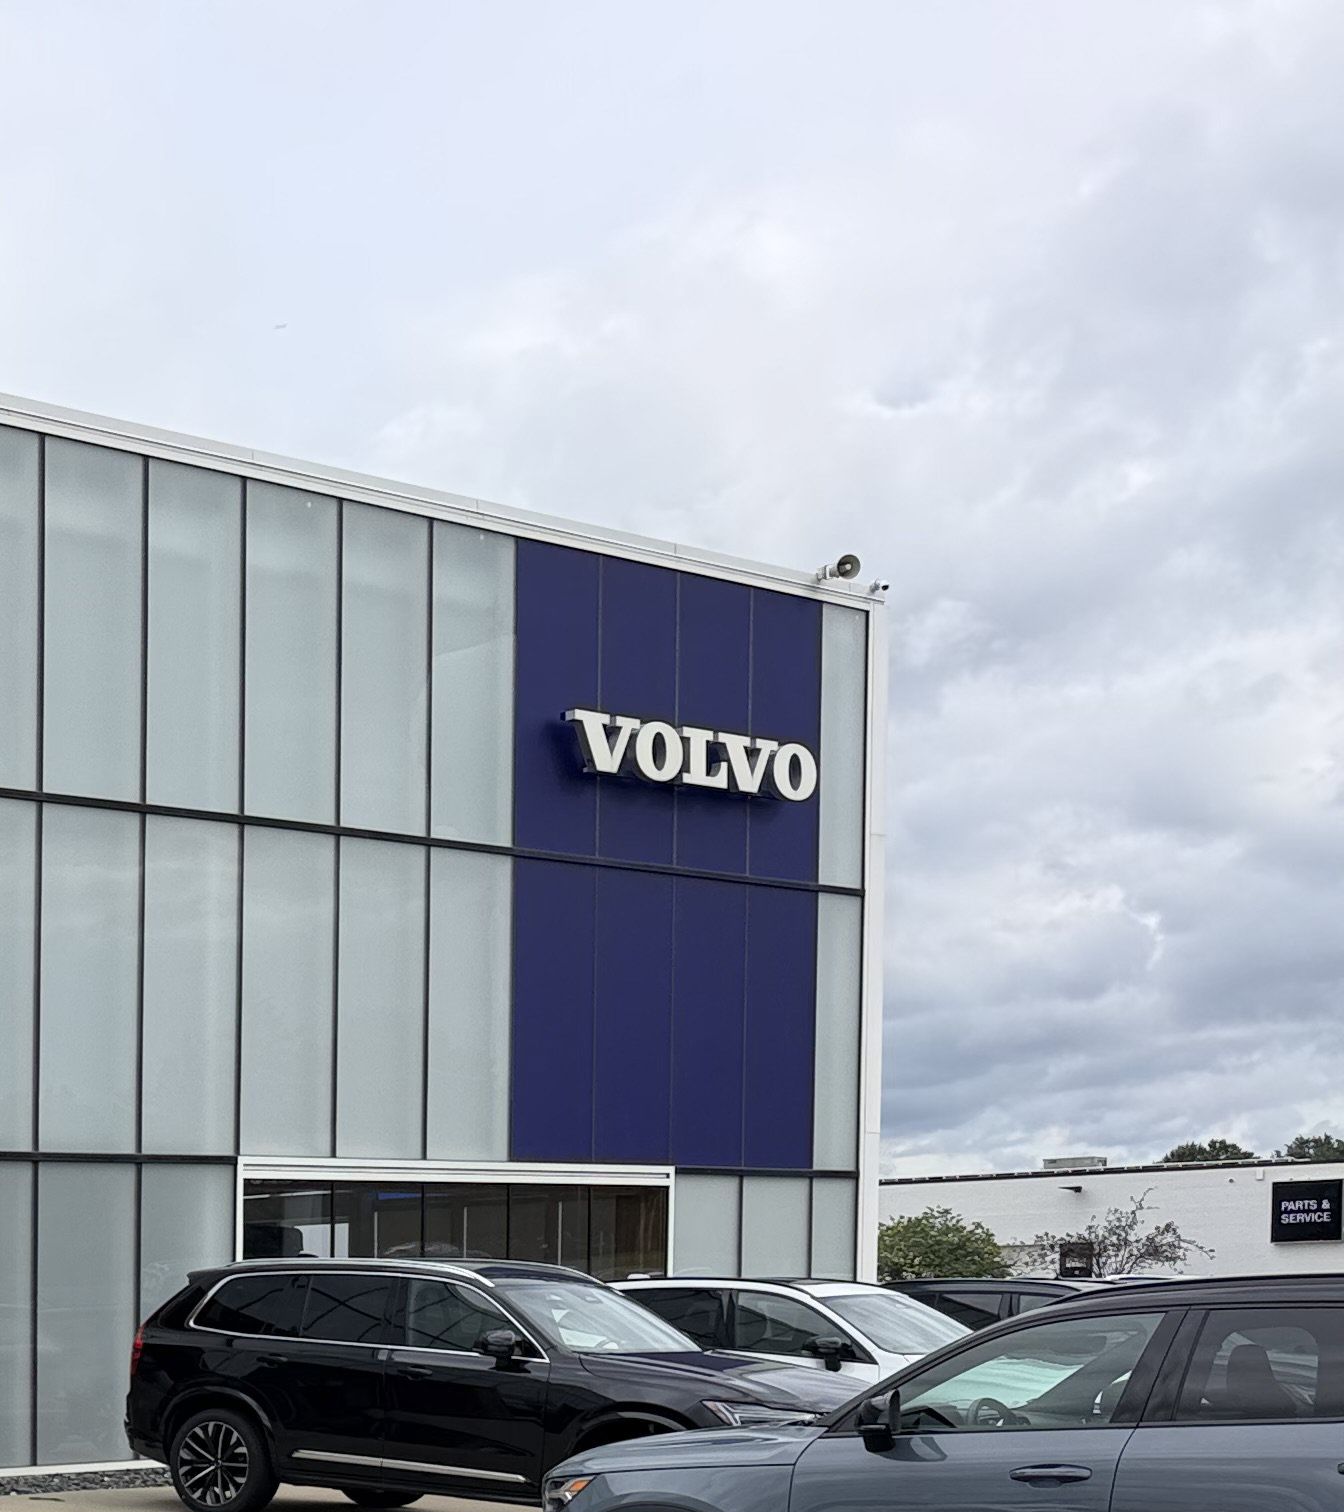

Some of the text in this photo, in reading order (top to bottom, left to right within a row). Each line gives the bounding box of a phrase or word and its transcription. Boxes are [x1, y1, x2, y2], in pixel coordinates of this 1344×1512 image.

[565, 708, 818, 802] VOLVO
[1281, 1199, 1330, 1211] PARTS &
[1280, 1212, 1332, 1224] SERVICE
